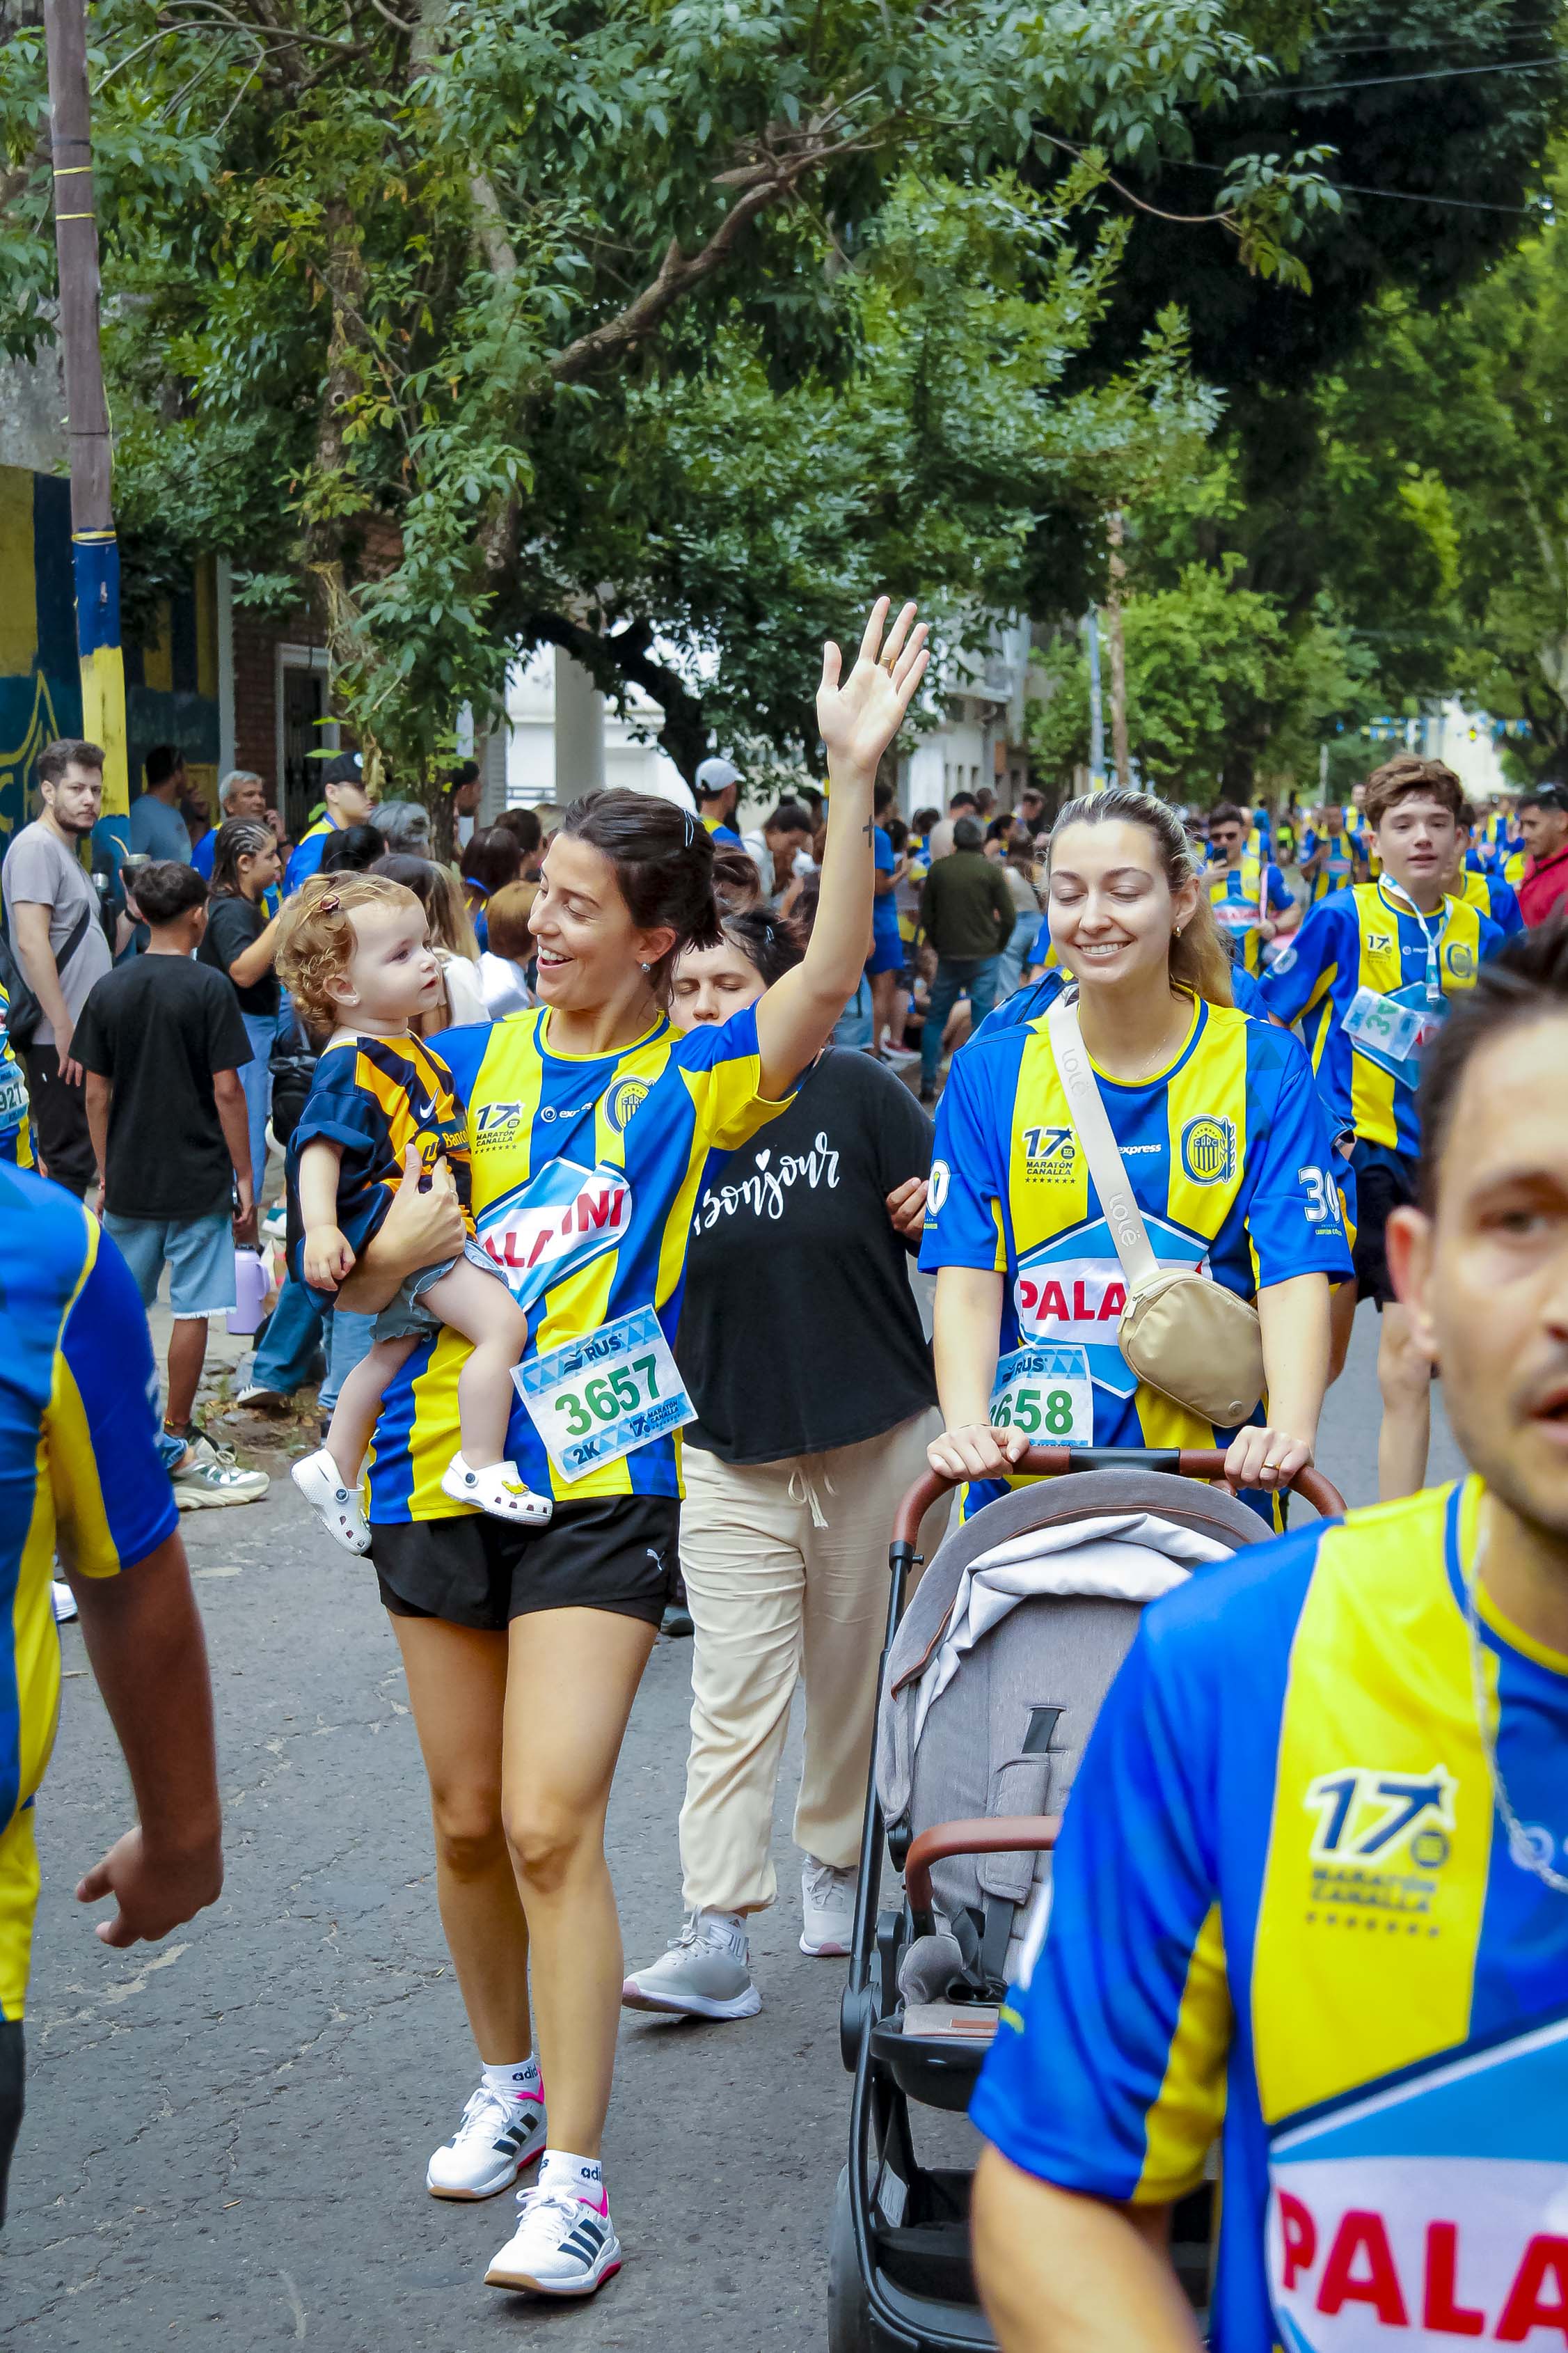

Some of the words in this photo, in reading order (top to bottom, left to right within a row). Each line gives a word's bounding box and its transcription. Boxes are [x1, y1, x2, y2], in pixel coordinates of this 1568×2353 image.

[476, 1101, 523, 1131] 17
[476, 1130, 516, 1141] MARATÓN
[476, 1136, 514, 1147] CANALLA
[1024, 1127, 1074, 1158] 17
[1194, 1135, 1218, 1147] CARC
[1118, 1144, 1162, 1156] express
[1026, 1160, 1073, 1168] MARATÓN
[585, 1335, 622, 1361] RUS
[1014, 1357, 1045, 1376] RUS
[555, 1353, 660, 1435] 3657
[573, 1440, 601, 1465] 2K
[1313, 1772, 1449, 1859] 17
